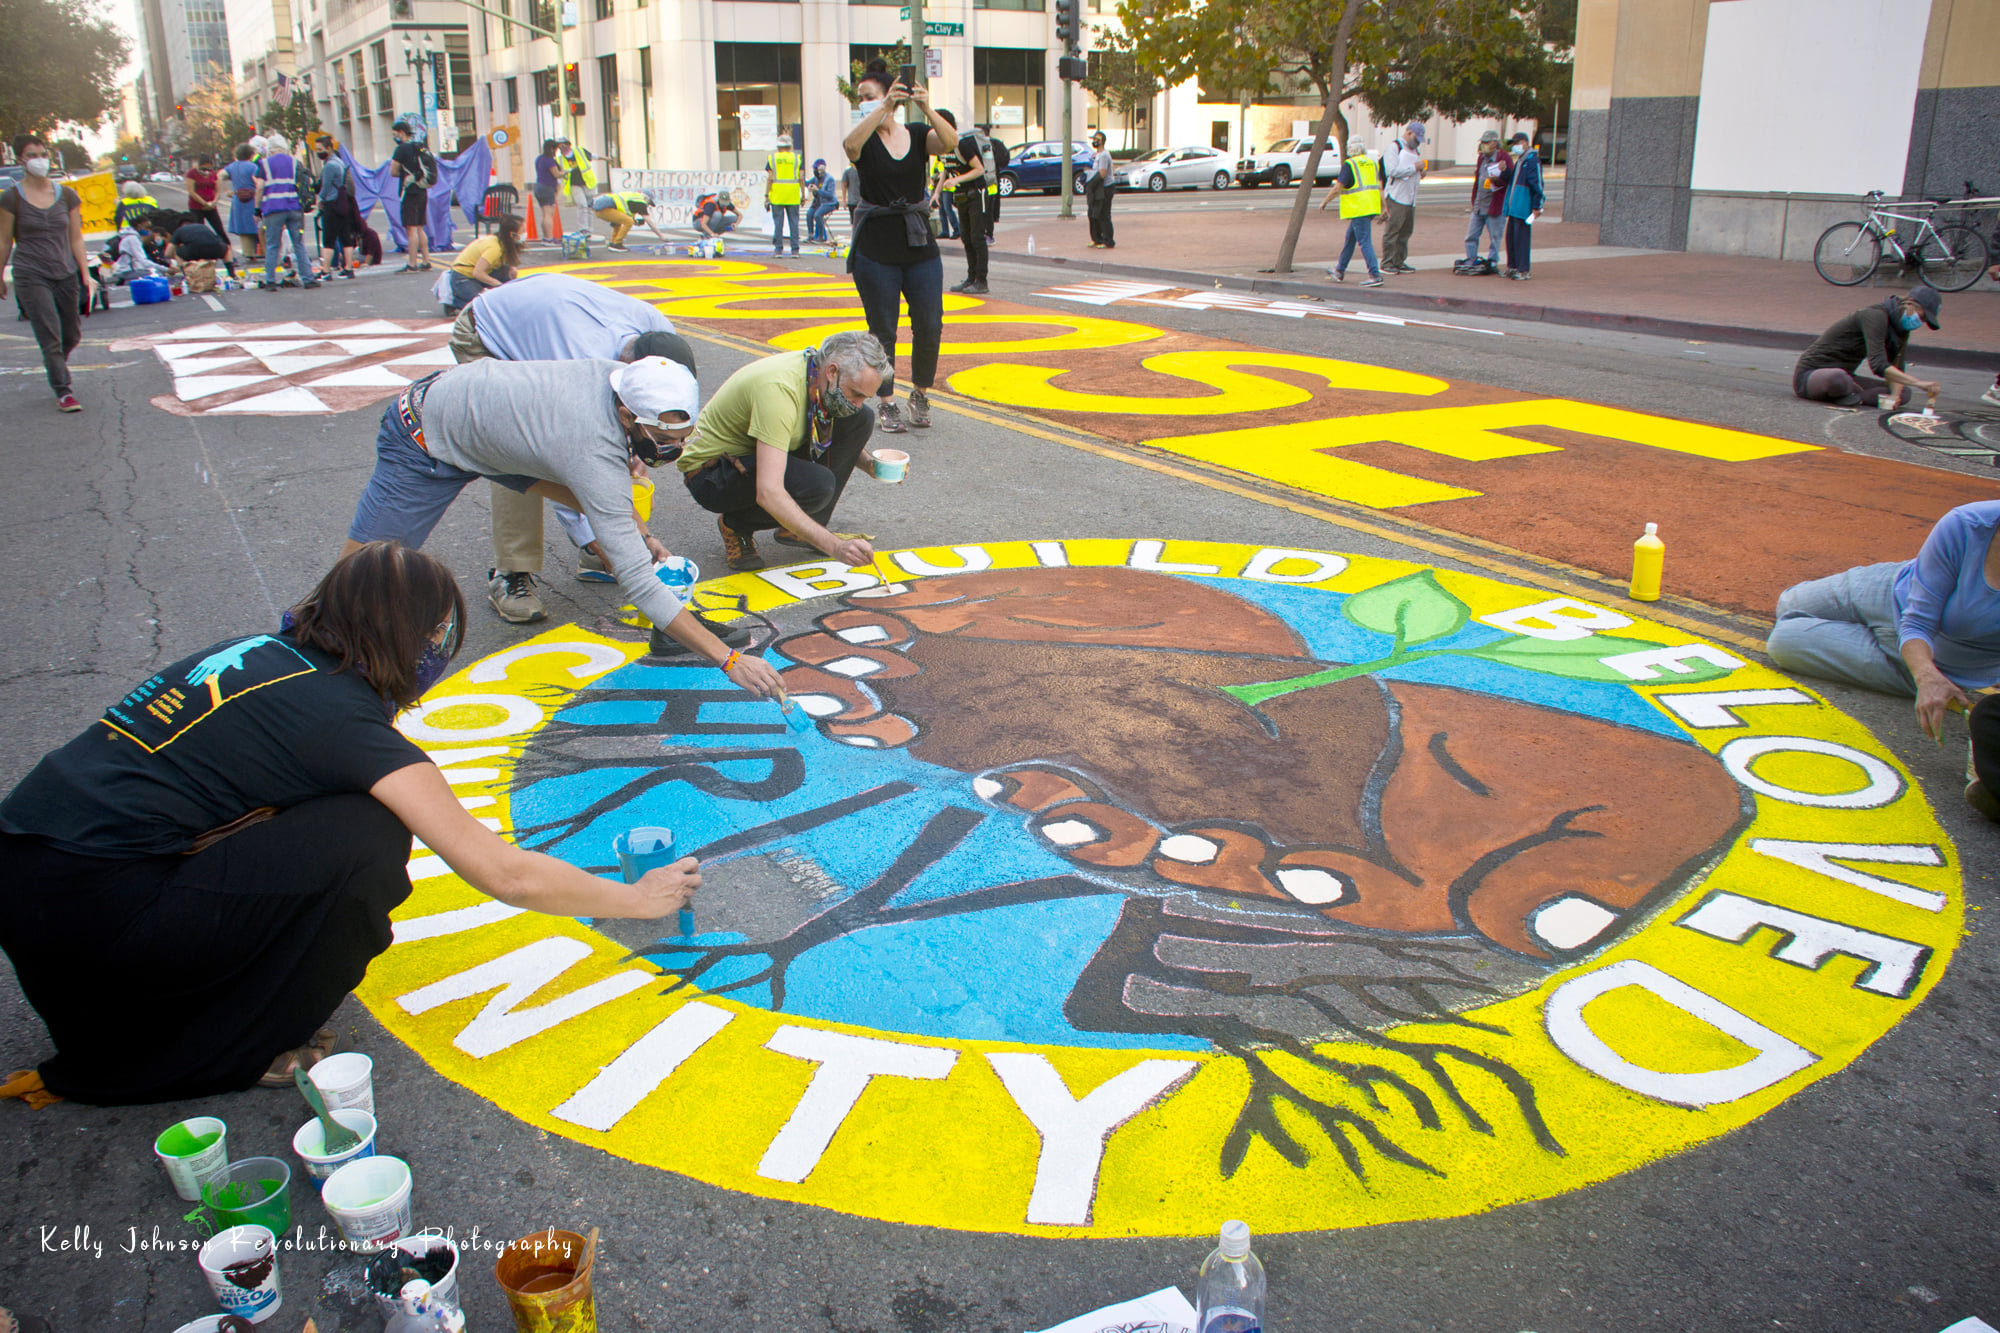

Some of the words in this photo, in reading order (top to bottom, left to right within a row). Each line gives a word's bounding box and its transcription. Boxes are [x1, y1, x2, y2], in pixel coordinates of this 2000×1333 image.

[934, 24, 952, 36] Clay
[517, 259, 1822, 511] CHOOSE
[756, 540, 1350, 600] BUILD
[1480, 597, 1948, 1109] BELOVED
[219, 1290, 264, 1306] MISO
